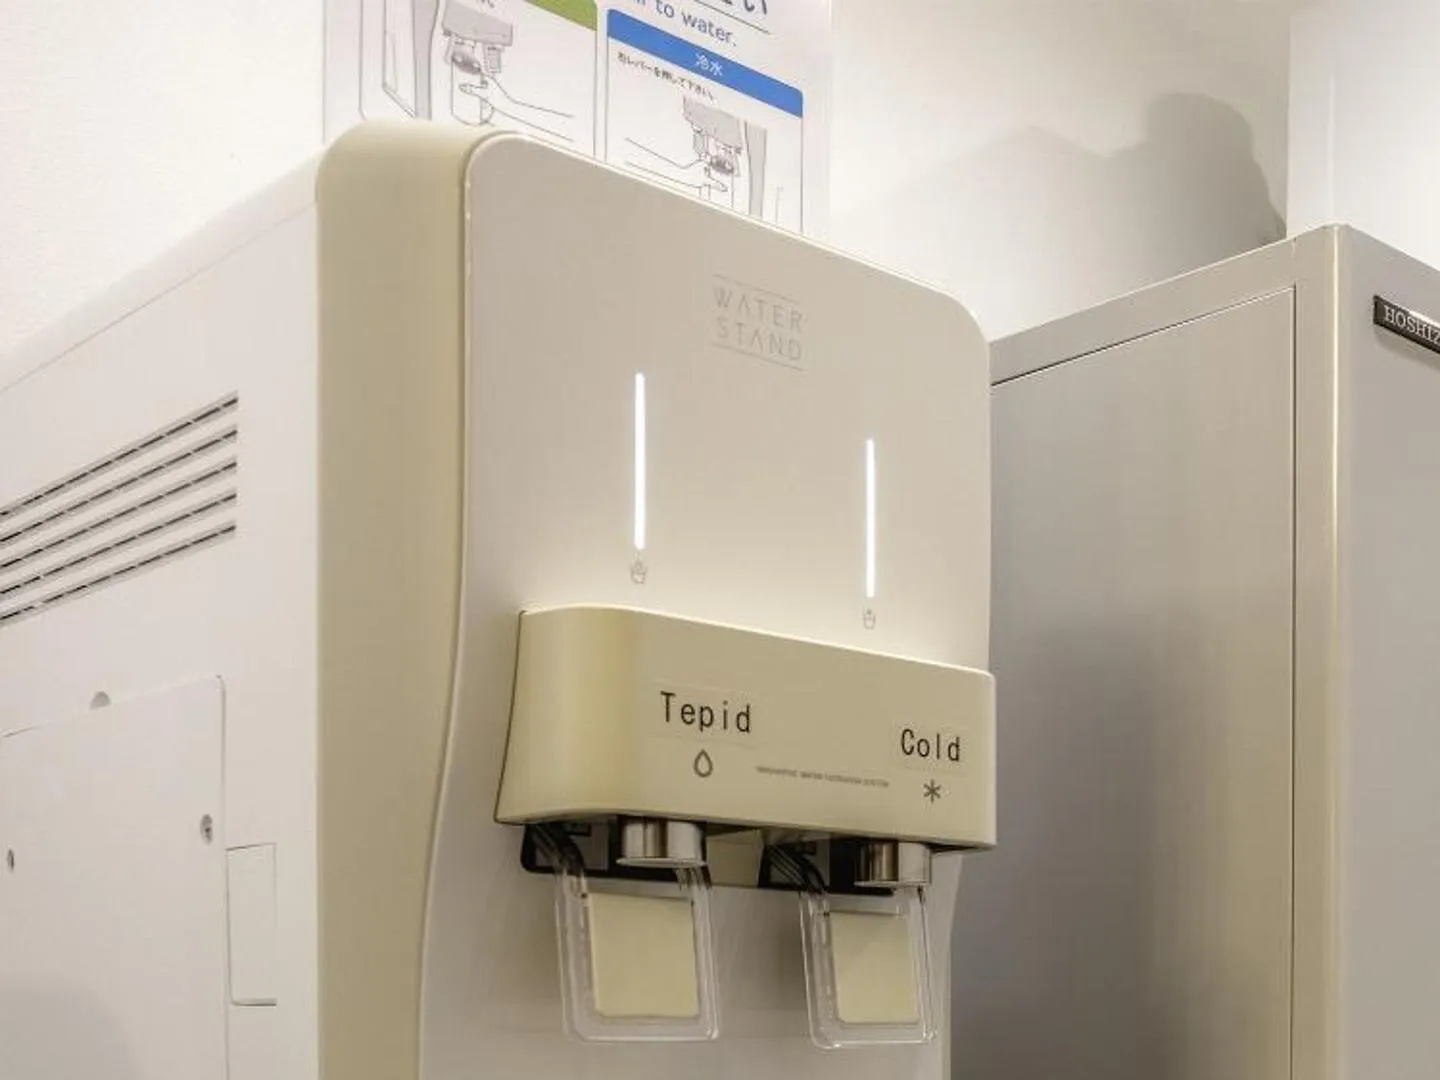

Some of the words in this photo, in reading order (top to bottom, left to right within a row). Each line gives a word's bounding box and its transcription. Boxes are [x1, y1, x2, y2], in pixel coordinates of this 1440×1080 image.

[656, 0, 675, 18] to
[681, 11, 737, 47] water.
[713, 286, 804, 333] WATER
[715, 314, 804, 363] STAND
[660, 691, 752, 735] Tepid
[900, 728, 961, 762] Cold
